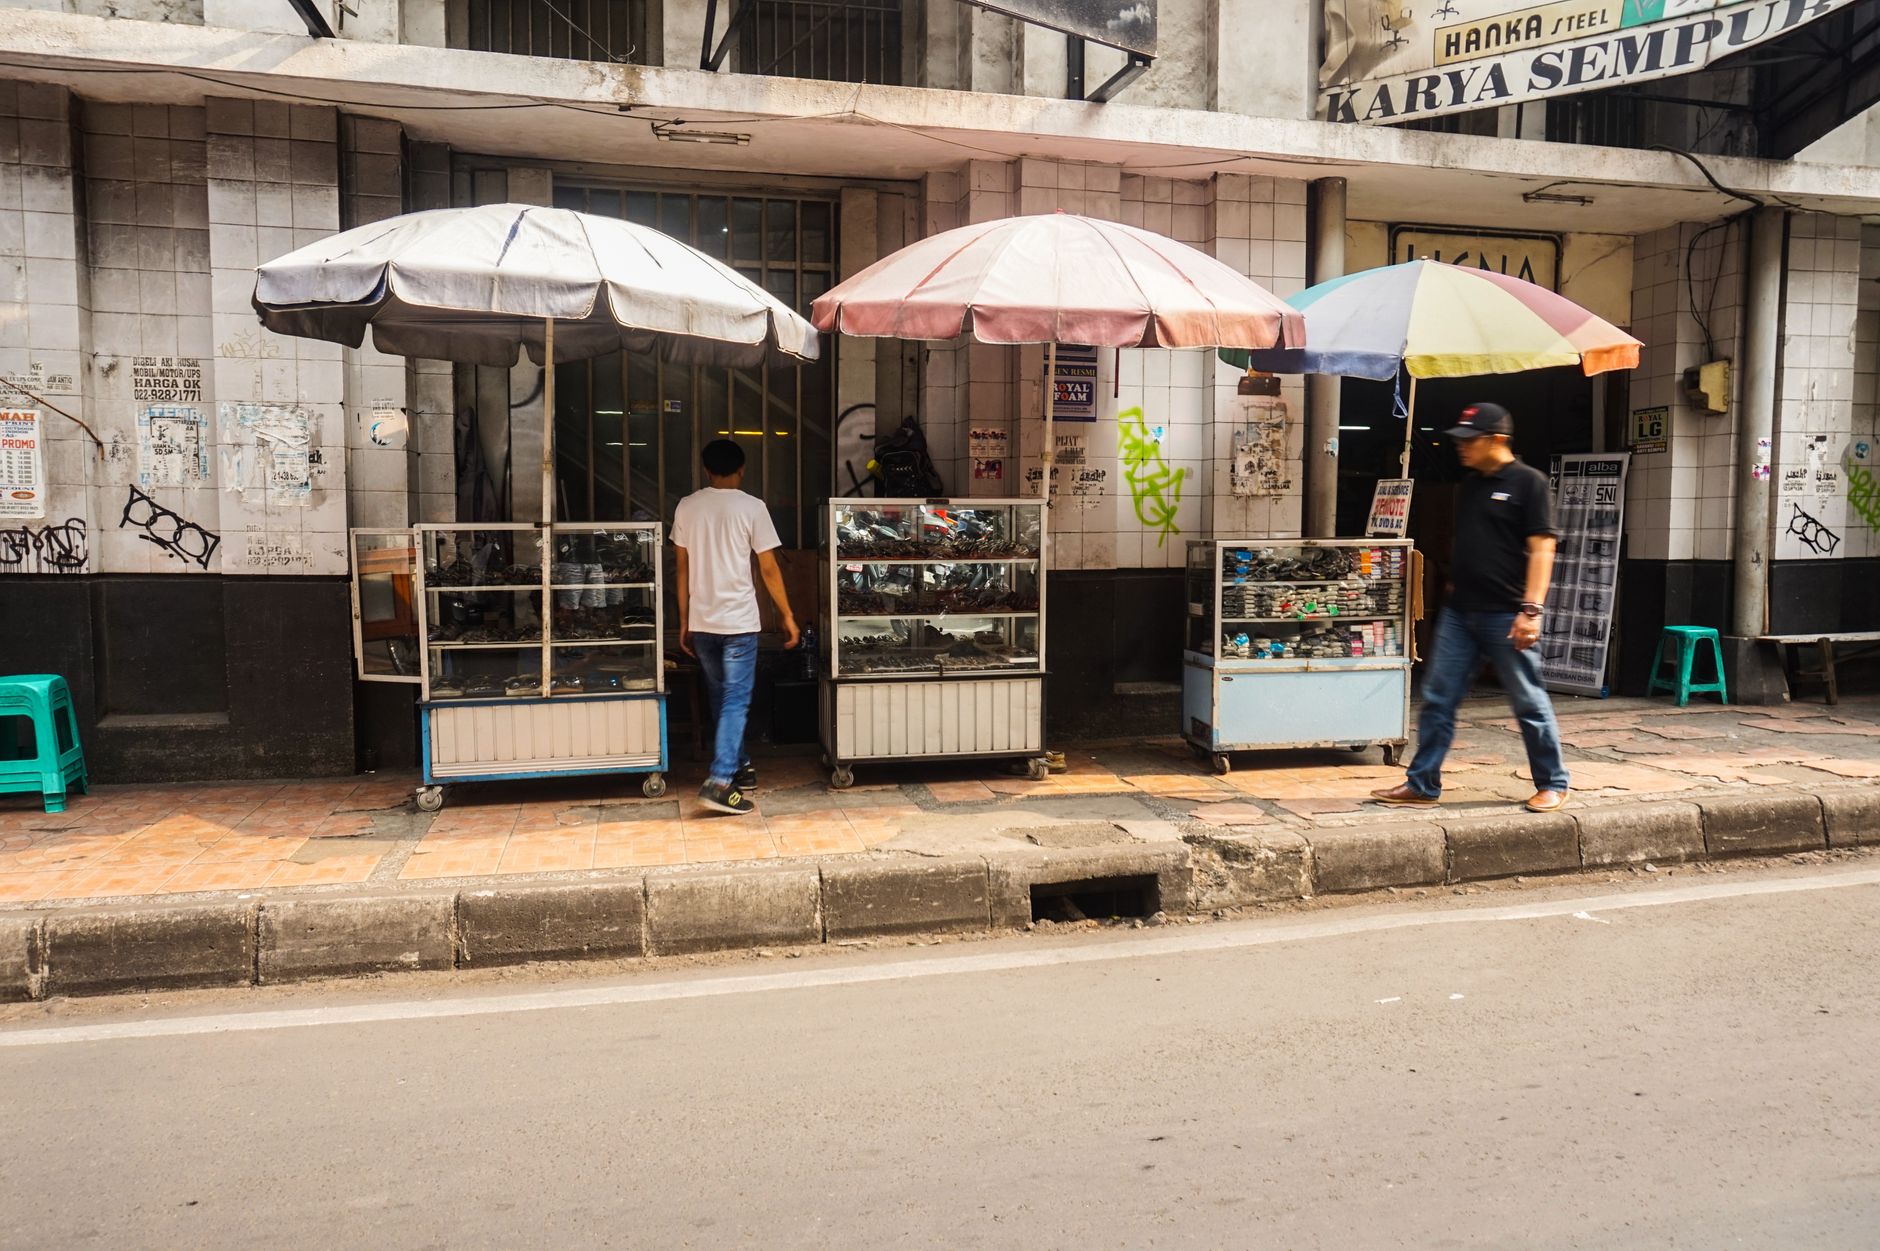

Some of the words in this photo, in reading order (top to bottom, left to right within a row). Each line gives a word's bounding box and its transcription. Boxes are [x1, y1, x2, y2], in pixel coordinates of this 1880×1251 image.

[1446, 14, 1542, 58] HANKA
[1550, 9, 1609, 36] STEEL
[1327, 62, 1513, 124] KARYA
[161, 357, 173, 367] AKI
[133, 367, 201, 378] MOBIL/MOTOR/UPS
[1071, 368, 1096, 376] RESMI
[134, 378, 179, 388] HARGA
[183, 379, 201, 389] OK
[1053, 383, 1090, 393] ROYAL
[1054, 392, 1088, 402] FOAM
[1639, 414, 1664, 422] ROYAL
[1638, 422, 1662, 438] LG
[2, 439, 36, 449] PROMO
[1588, 462, 1618, 472] alba
[1595, 487, 1617, 502] SNI
[1374, 498, 1406, 517] REMOTE
[1379, 518, 1389, 528] DVD
[1395, 519, 1403, 529] AC
[1550, 671, 1577, 681] DIPESAN
[1577, 673, 1596, 684] DISINI
